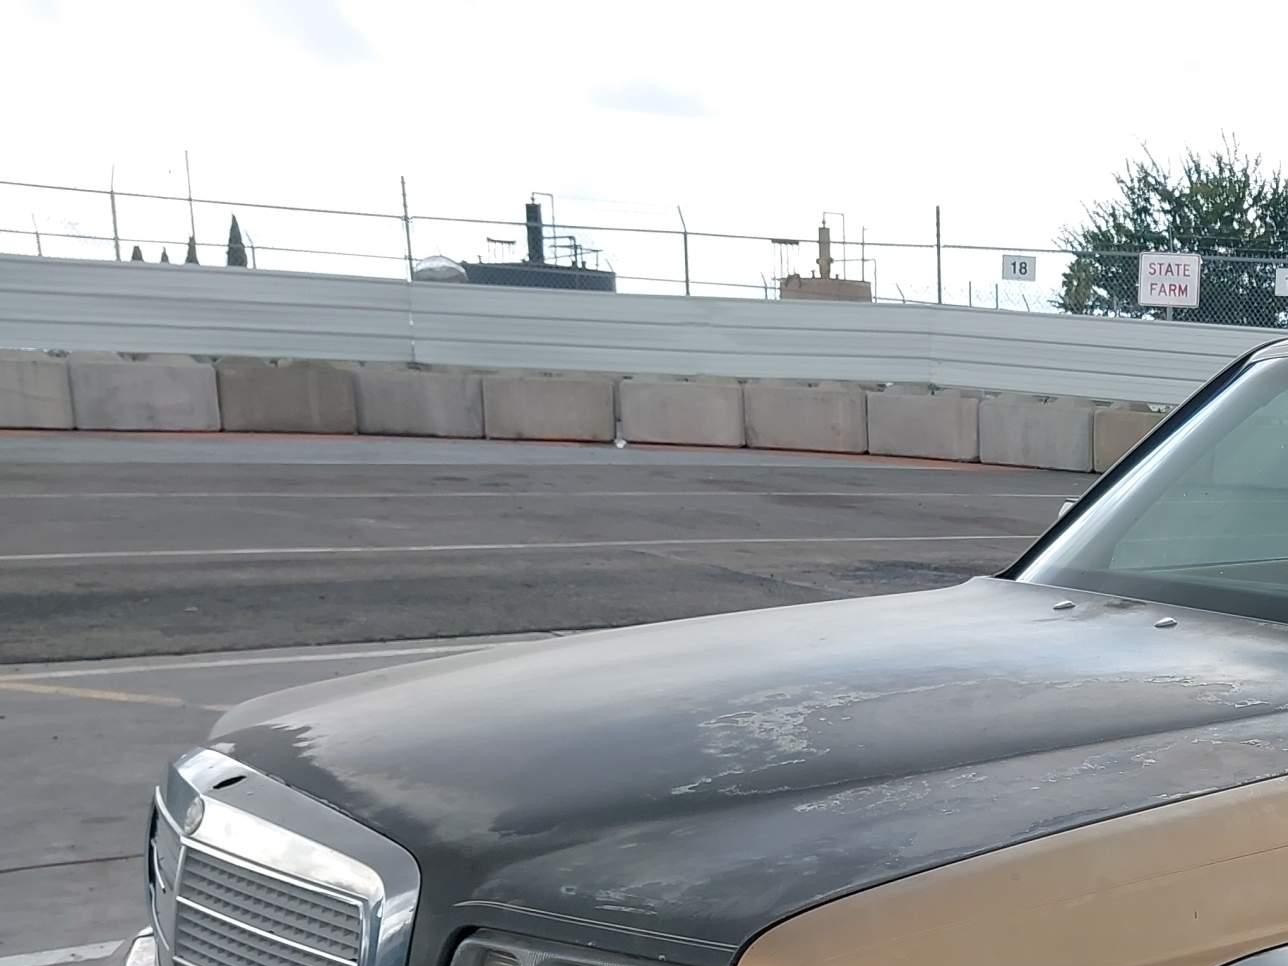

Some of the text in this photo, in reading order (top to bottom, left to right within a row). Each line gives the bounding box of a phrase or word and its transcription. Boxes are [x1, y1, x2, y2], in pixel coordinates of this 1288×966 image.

[1011, 261, 1028, 276] 18
[1148, 262, 1191, 278] STATE
[1150, 282, 1188, 297] FARM
